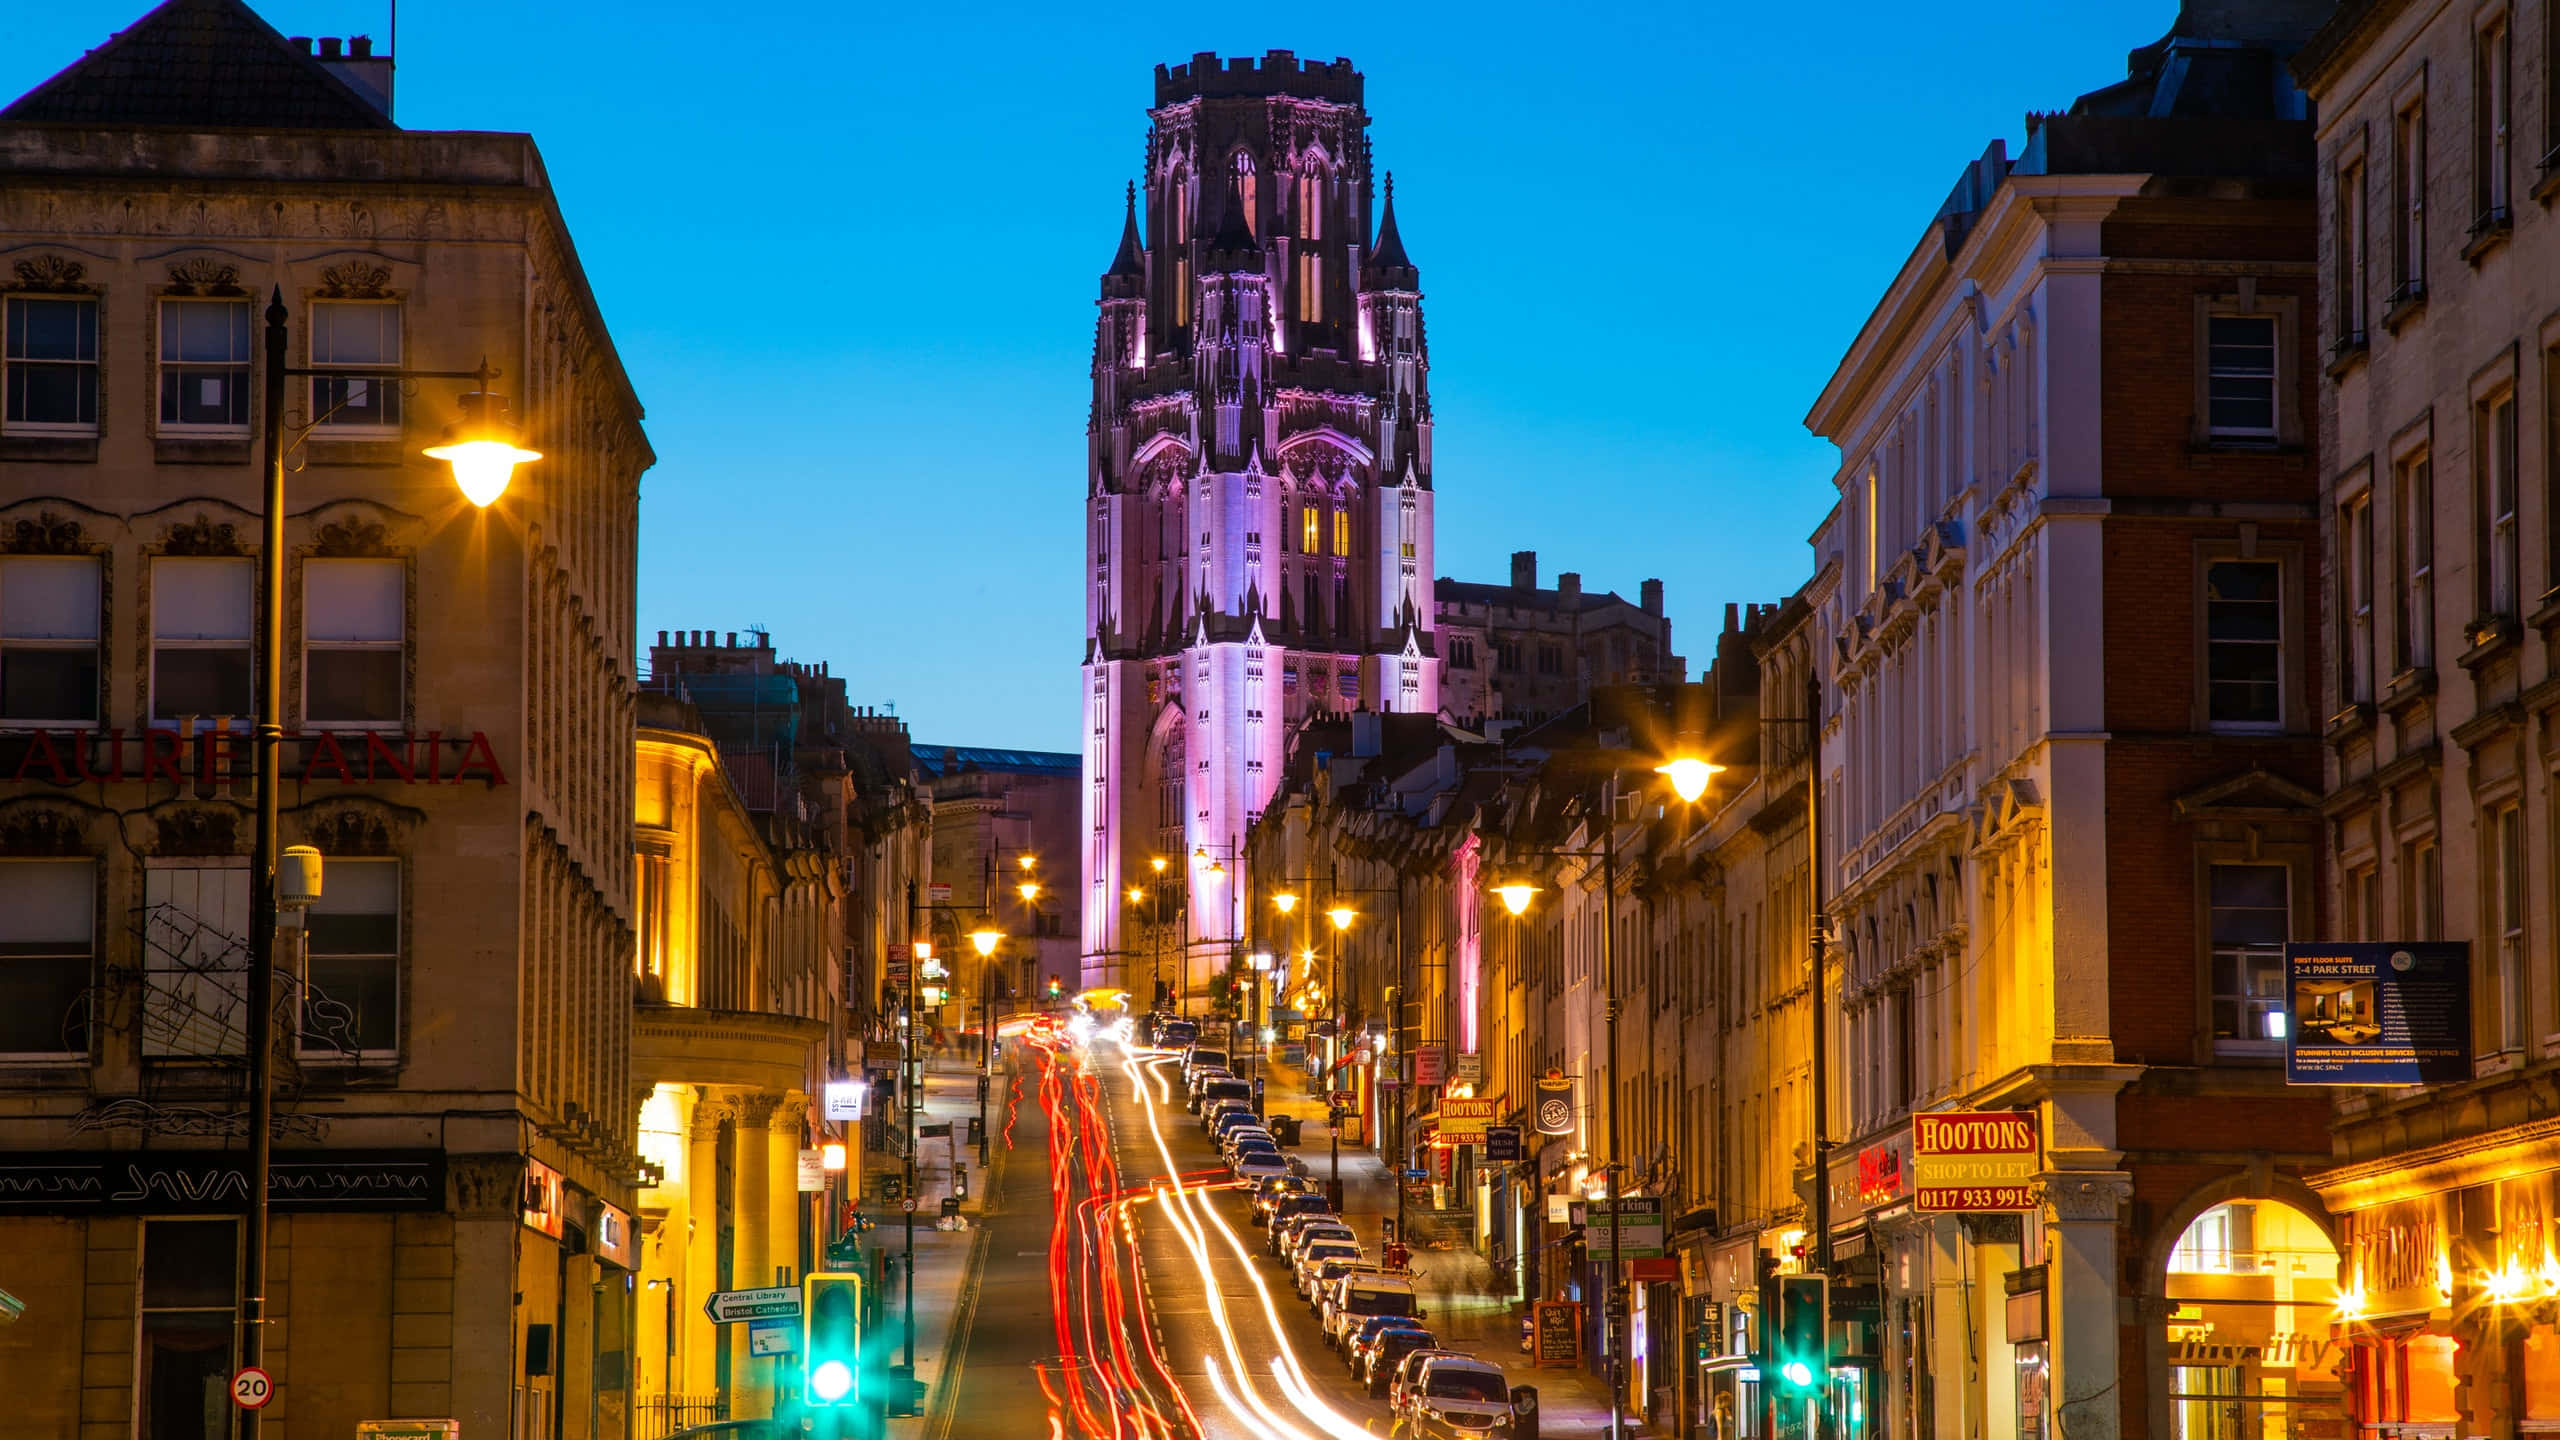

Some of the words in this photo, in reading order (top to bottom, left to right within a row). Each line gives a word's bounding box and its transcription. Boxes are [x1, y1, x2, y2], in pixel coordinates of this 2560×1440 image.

[9, 727, 511, 785] AUREANIA
[2294, 965, 2310, 974] 2-4
[2313, 965, 2339, 974] PARK
[2341, 965, 2376, 974] STREET
[1442, 1101, 1492, 1117] HOOTONS
[1441, 1134, 1459, 1143] 0117
[1461, 1134, 1474, 1143] 933
[1920, 1118, 2030, 1152] HOOTONS
[1923, 1163, 1966, 1179] SHOP
[1968, 1163, 1992, 1179] TO
[1996, 1162, 2028, 1178] LET
[1595, 1199, 1625, 1213] aldr
[1627, 1198, 1653, 1214] king
[1920, 1190, 1959, 1208] 0117
[1963, 1189, 1992, 1207] 933
[1996, 1188, 2035, 1207] 9915
[723, 1293, 753, 1302] Central
[756, 1291, 786, 1300] Library
[725, 1307, 753, 1317] Bristol
[756, 1303, 797, 1315] Cathedral
[2262, 1331, 2331, 1370] fifty
[237, 1379, 268, 1397] 20
